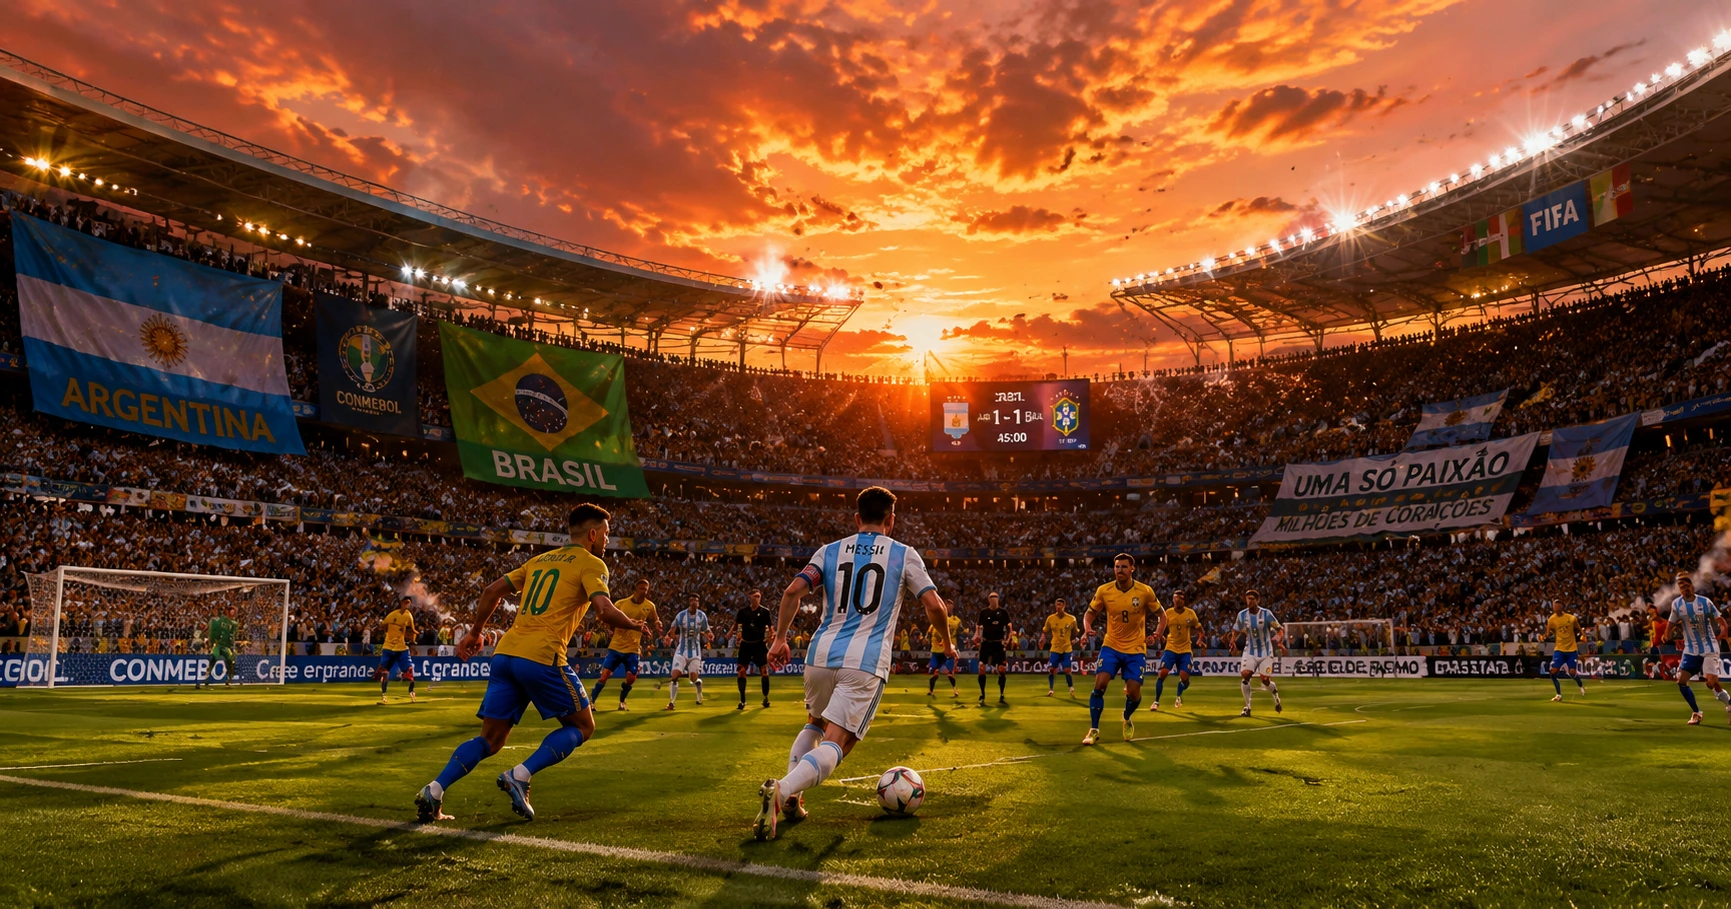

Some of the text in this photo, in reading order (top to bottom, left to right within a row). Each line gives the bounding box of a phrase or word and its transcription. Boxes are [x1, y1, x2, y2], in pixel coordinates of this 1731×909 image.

[1529, 199, 1580, 237] FIFA
[61, 376, 277, 443] ARGENTINA
[336, 389, 402, 415] CONMEBOL
[992, 409, 1000, 425] 1
[1013, 408, 1021, 424] 1
[491, 449, 618, 491] BRASIL
[1293, 471, 1350, 497] UMA
[1358, 460, 1397, 492] SÓ
[1353, 510, 1383, 528] DE
[521, 568, 560, 616] 10
[837, 561, 885, 615] 10
[1121, 610, 1129, 623] 8
